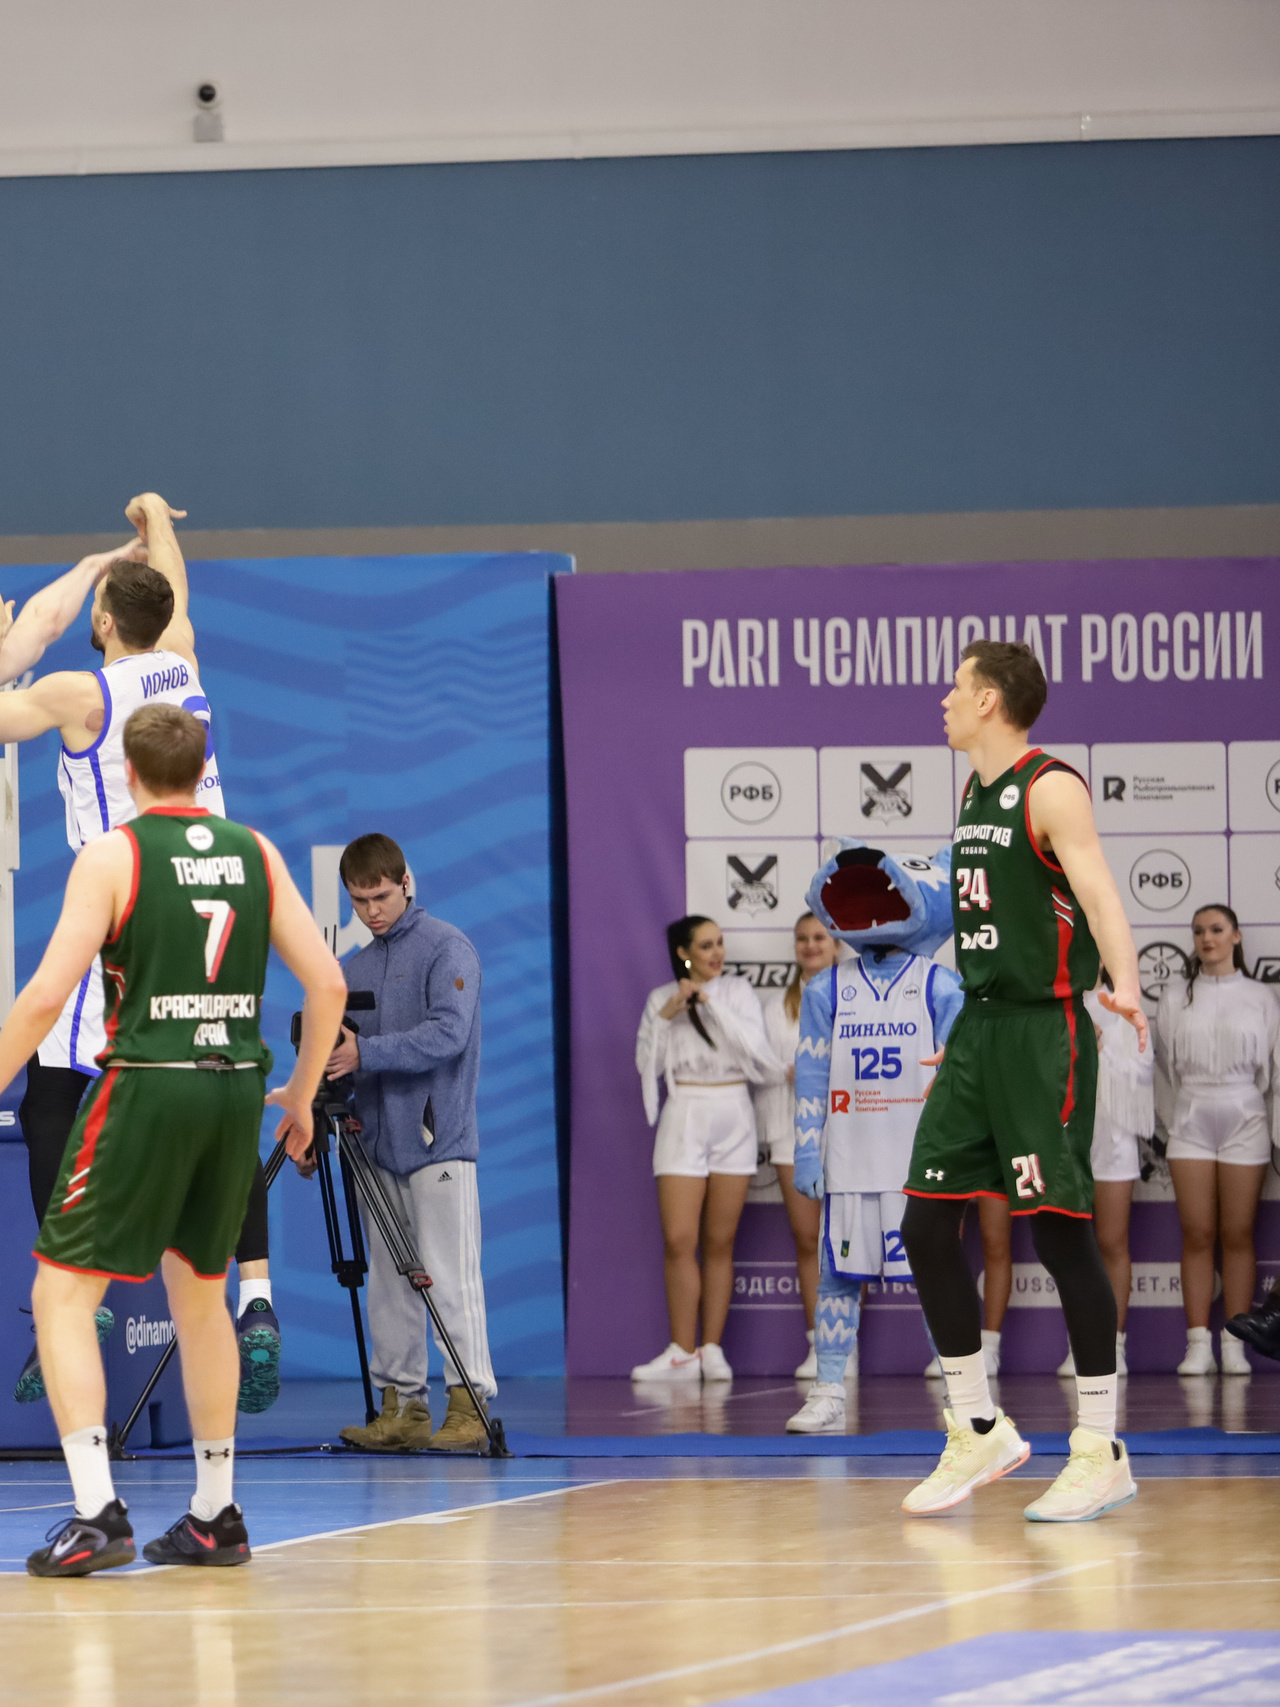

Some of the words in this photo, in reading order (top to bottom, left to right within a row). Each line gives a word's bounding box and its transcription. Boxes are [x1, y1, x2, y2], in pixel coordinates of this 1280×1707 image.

[681, 617, 780, 688] PARI
[1080, 610, 1264, 683] РОССИИ
[140, 664, 189, 699] ИОНОВ
[729, 784, 774, 801] РФБ
[960, 846, 989, 855] КУБАНЬ
[170, 856, 246, 886] ТЕМИРОВ
[1138, 872, 1183, 889] РФБ
[956, 868, 993, 911] 24
[190, 899, 237, 984] 7
[839, 1021, 918, 1039] ДИНАМО
[851, 1046, 903, 1081] 125
[1011, 1153, 1047, 1200] 24
